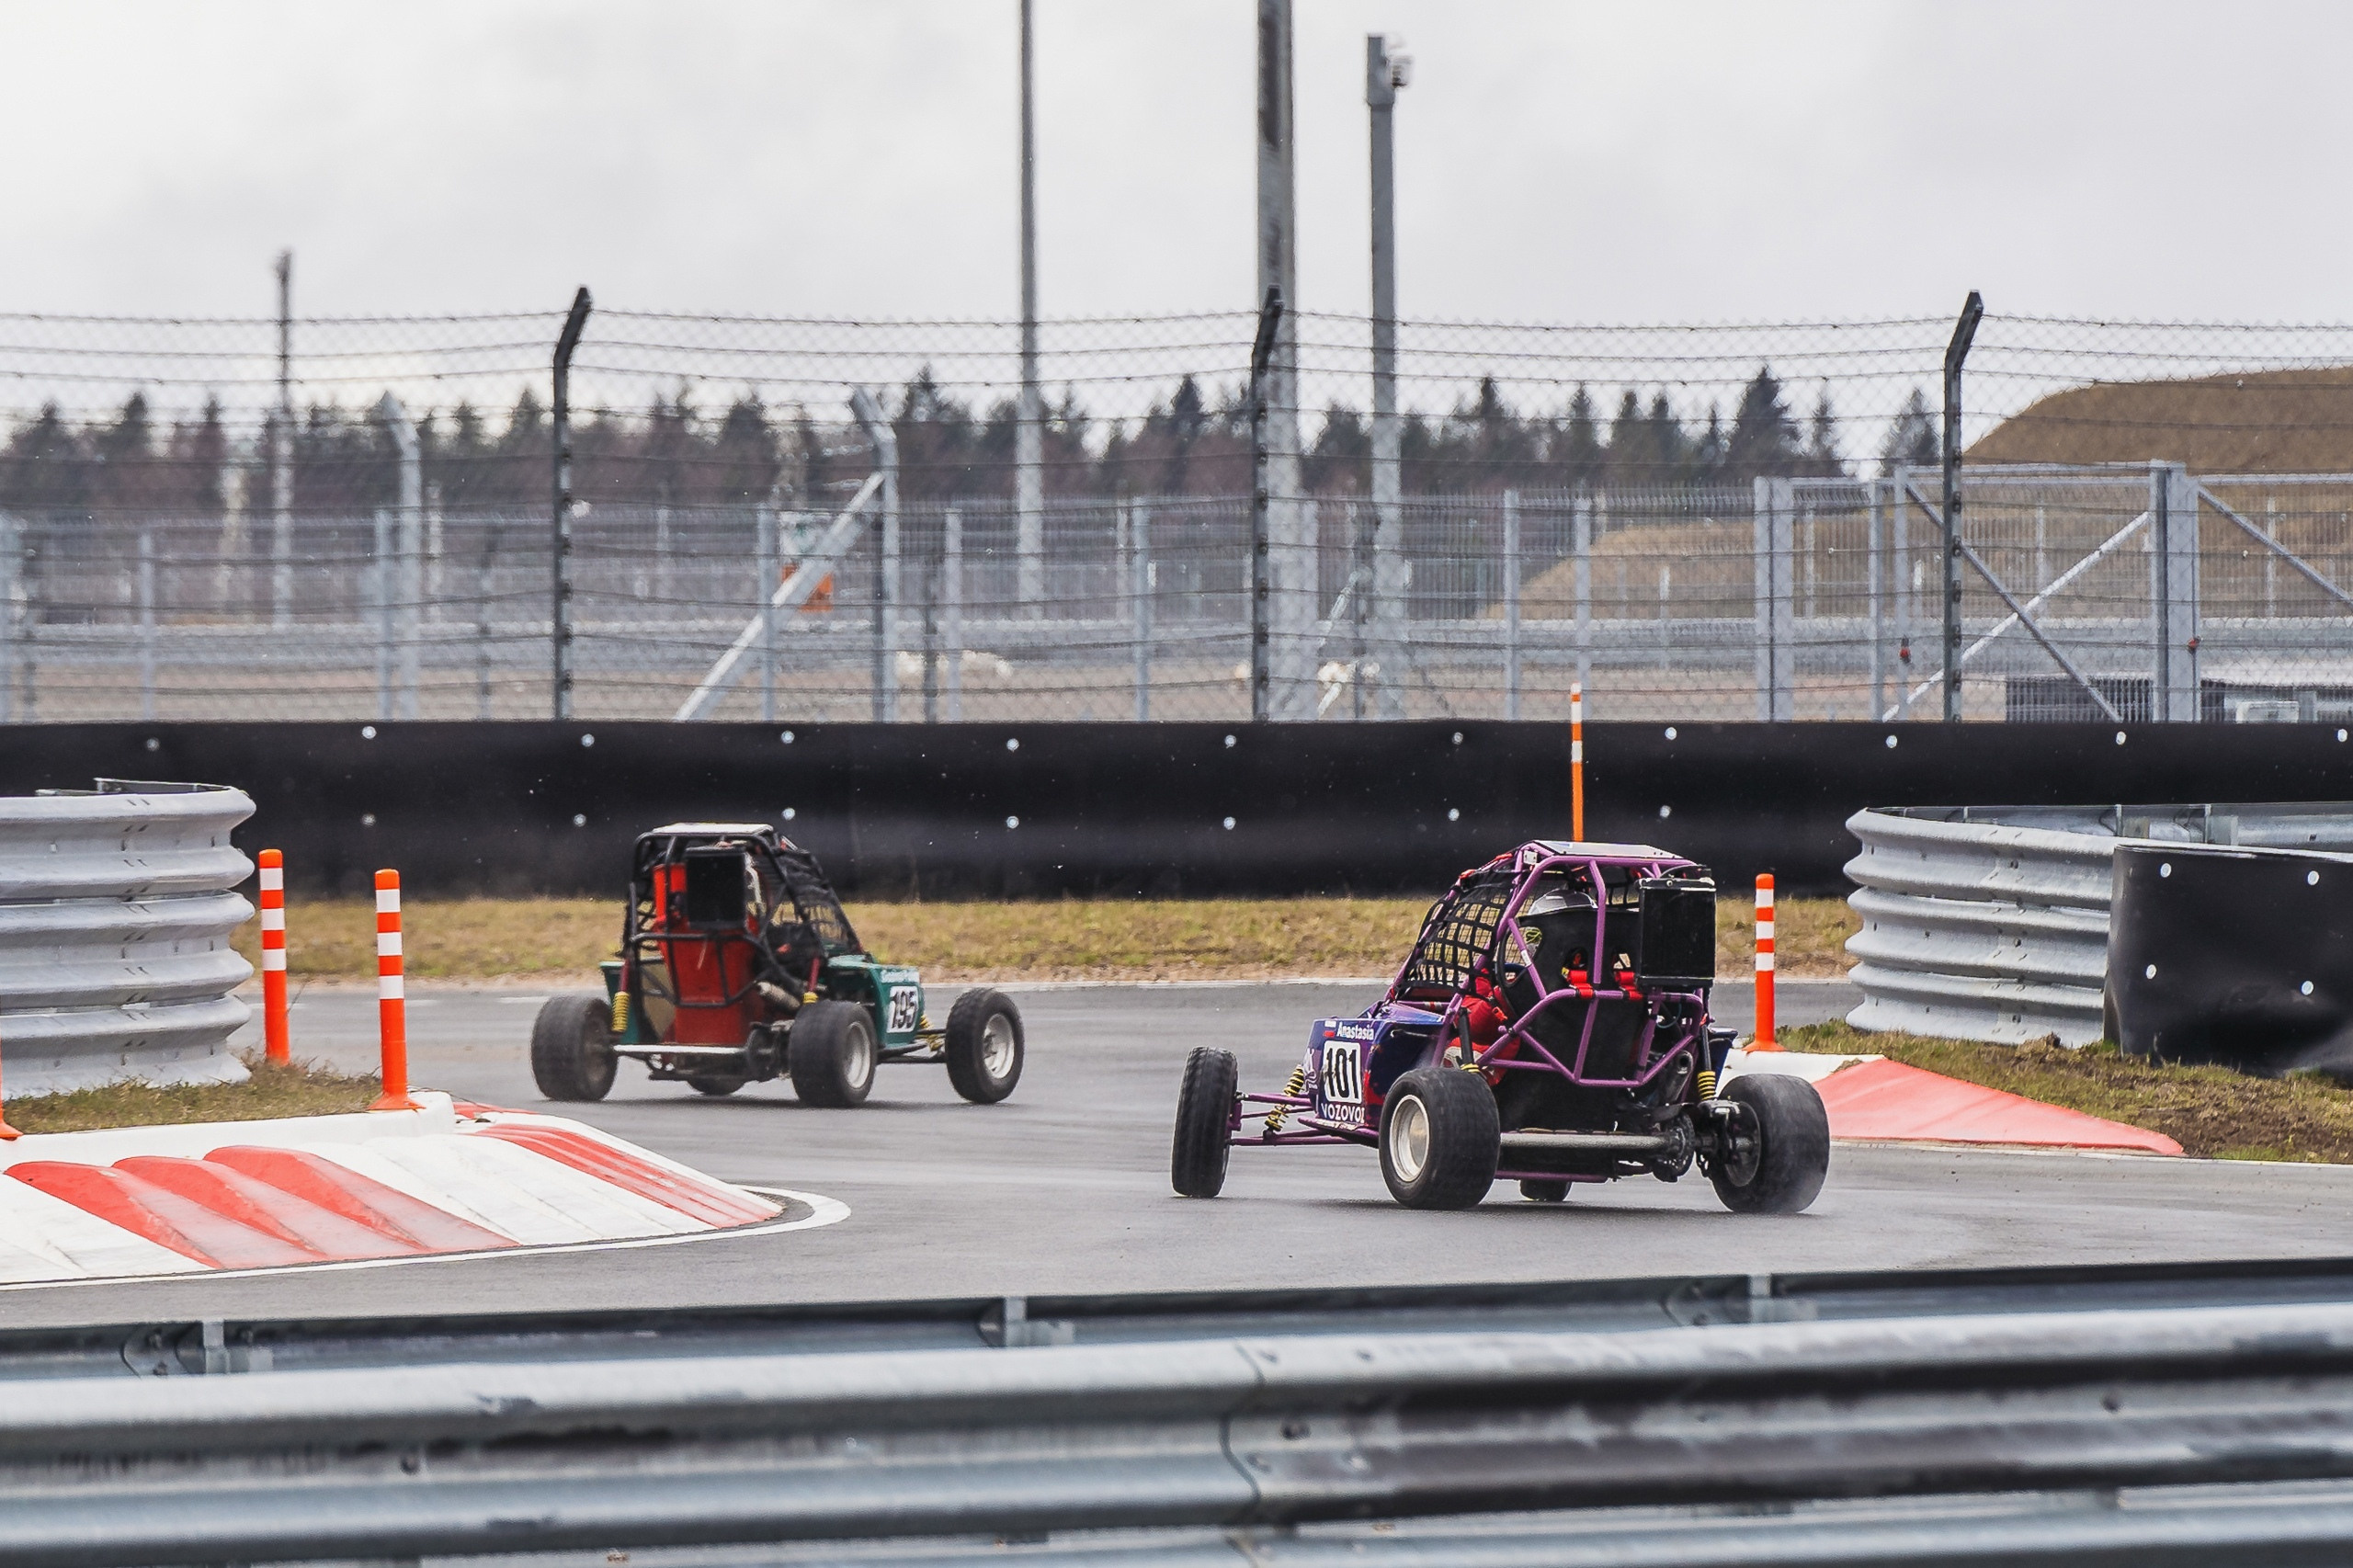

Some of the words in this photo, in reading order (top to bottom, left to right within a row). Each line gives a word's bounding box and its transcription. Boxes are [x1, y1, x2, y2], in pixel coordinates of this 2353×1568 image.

[891, 991, 916, 1028] 195
[1336, 1021, 1374, 1040] Anastasia
[1325, 1048, 1358, 1099] 101
